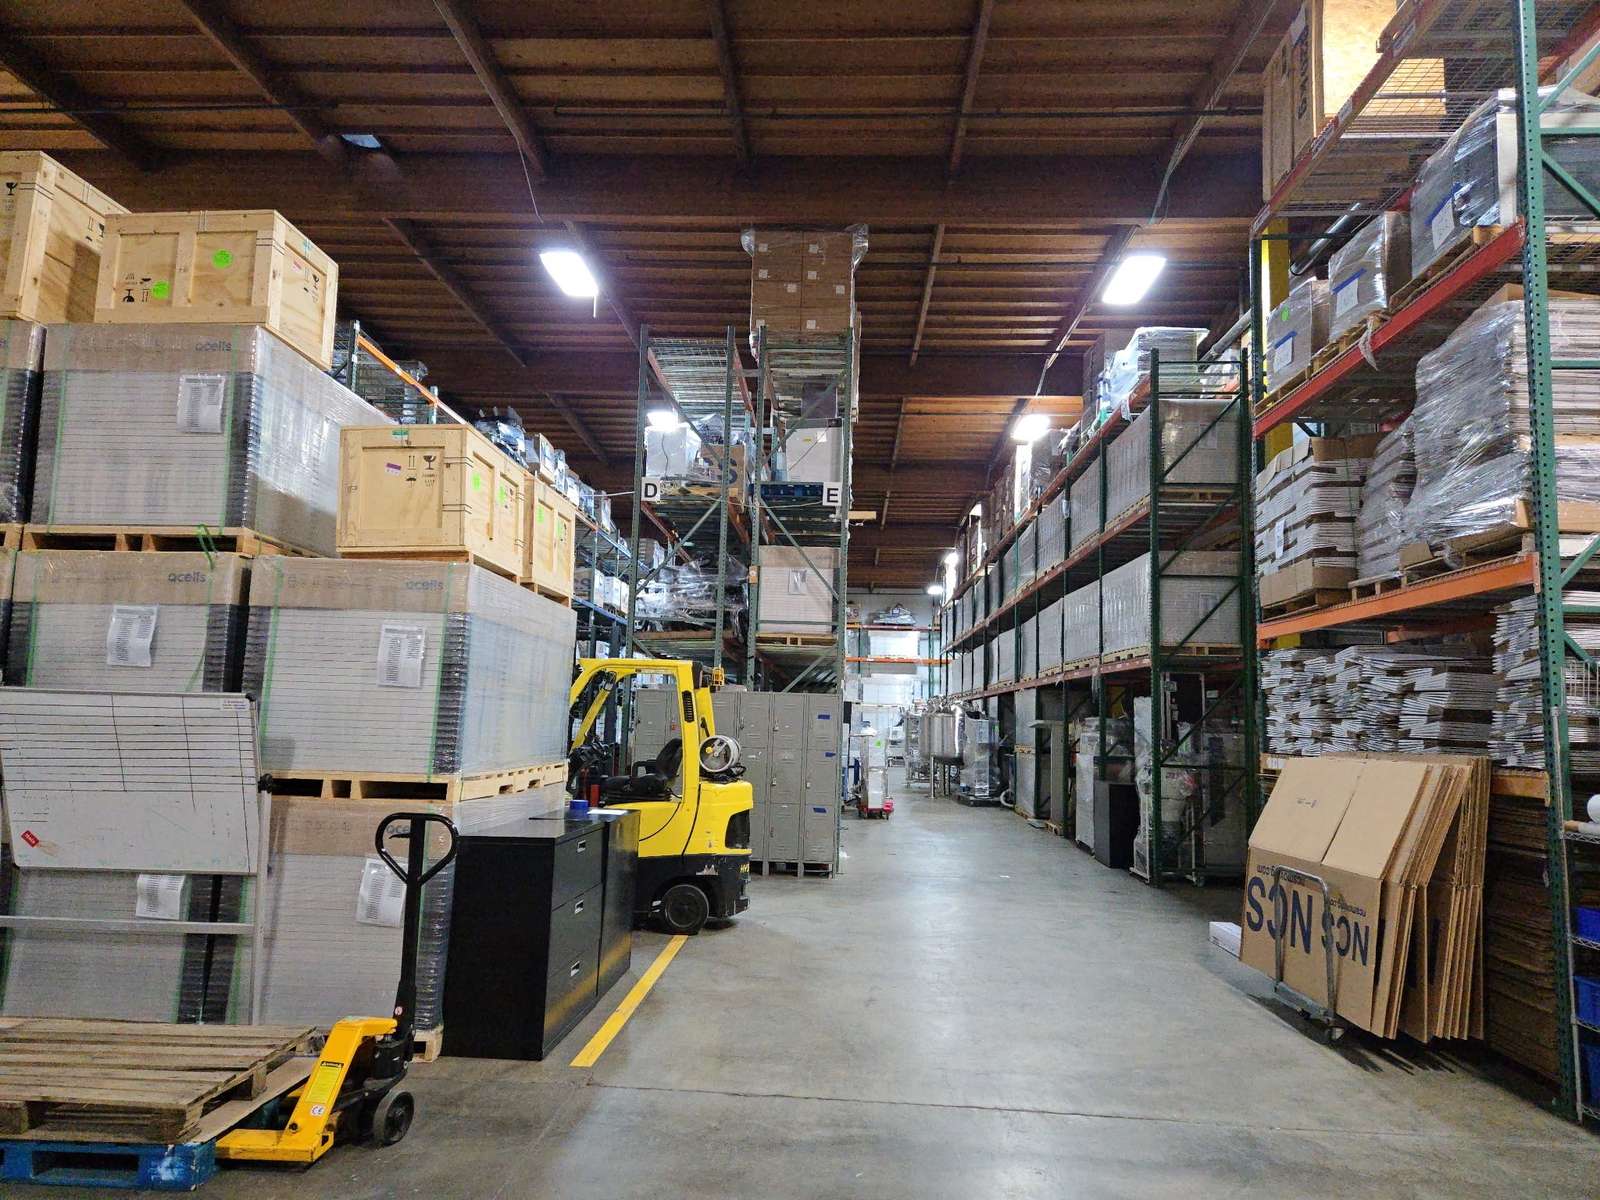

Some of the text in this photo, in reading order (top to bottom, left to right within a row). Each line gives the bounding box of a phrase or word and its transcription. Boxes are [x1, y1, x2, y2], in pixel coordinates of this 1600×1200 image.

[644, 483, 657, 498] D
[827, 488, 839, 502] E
[168, 571, 206, 584] qcells
[1246, 876, 1313, 954] NCS
[1321, 911, 1370, 967] NCS
